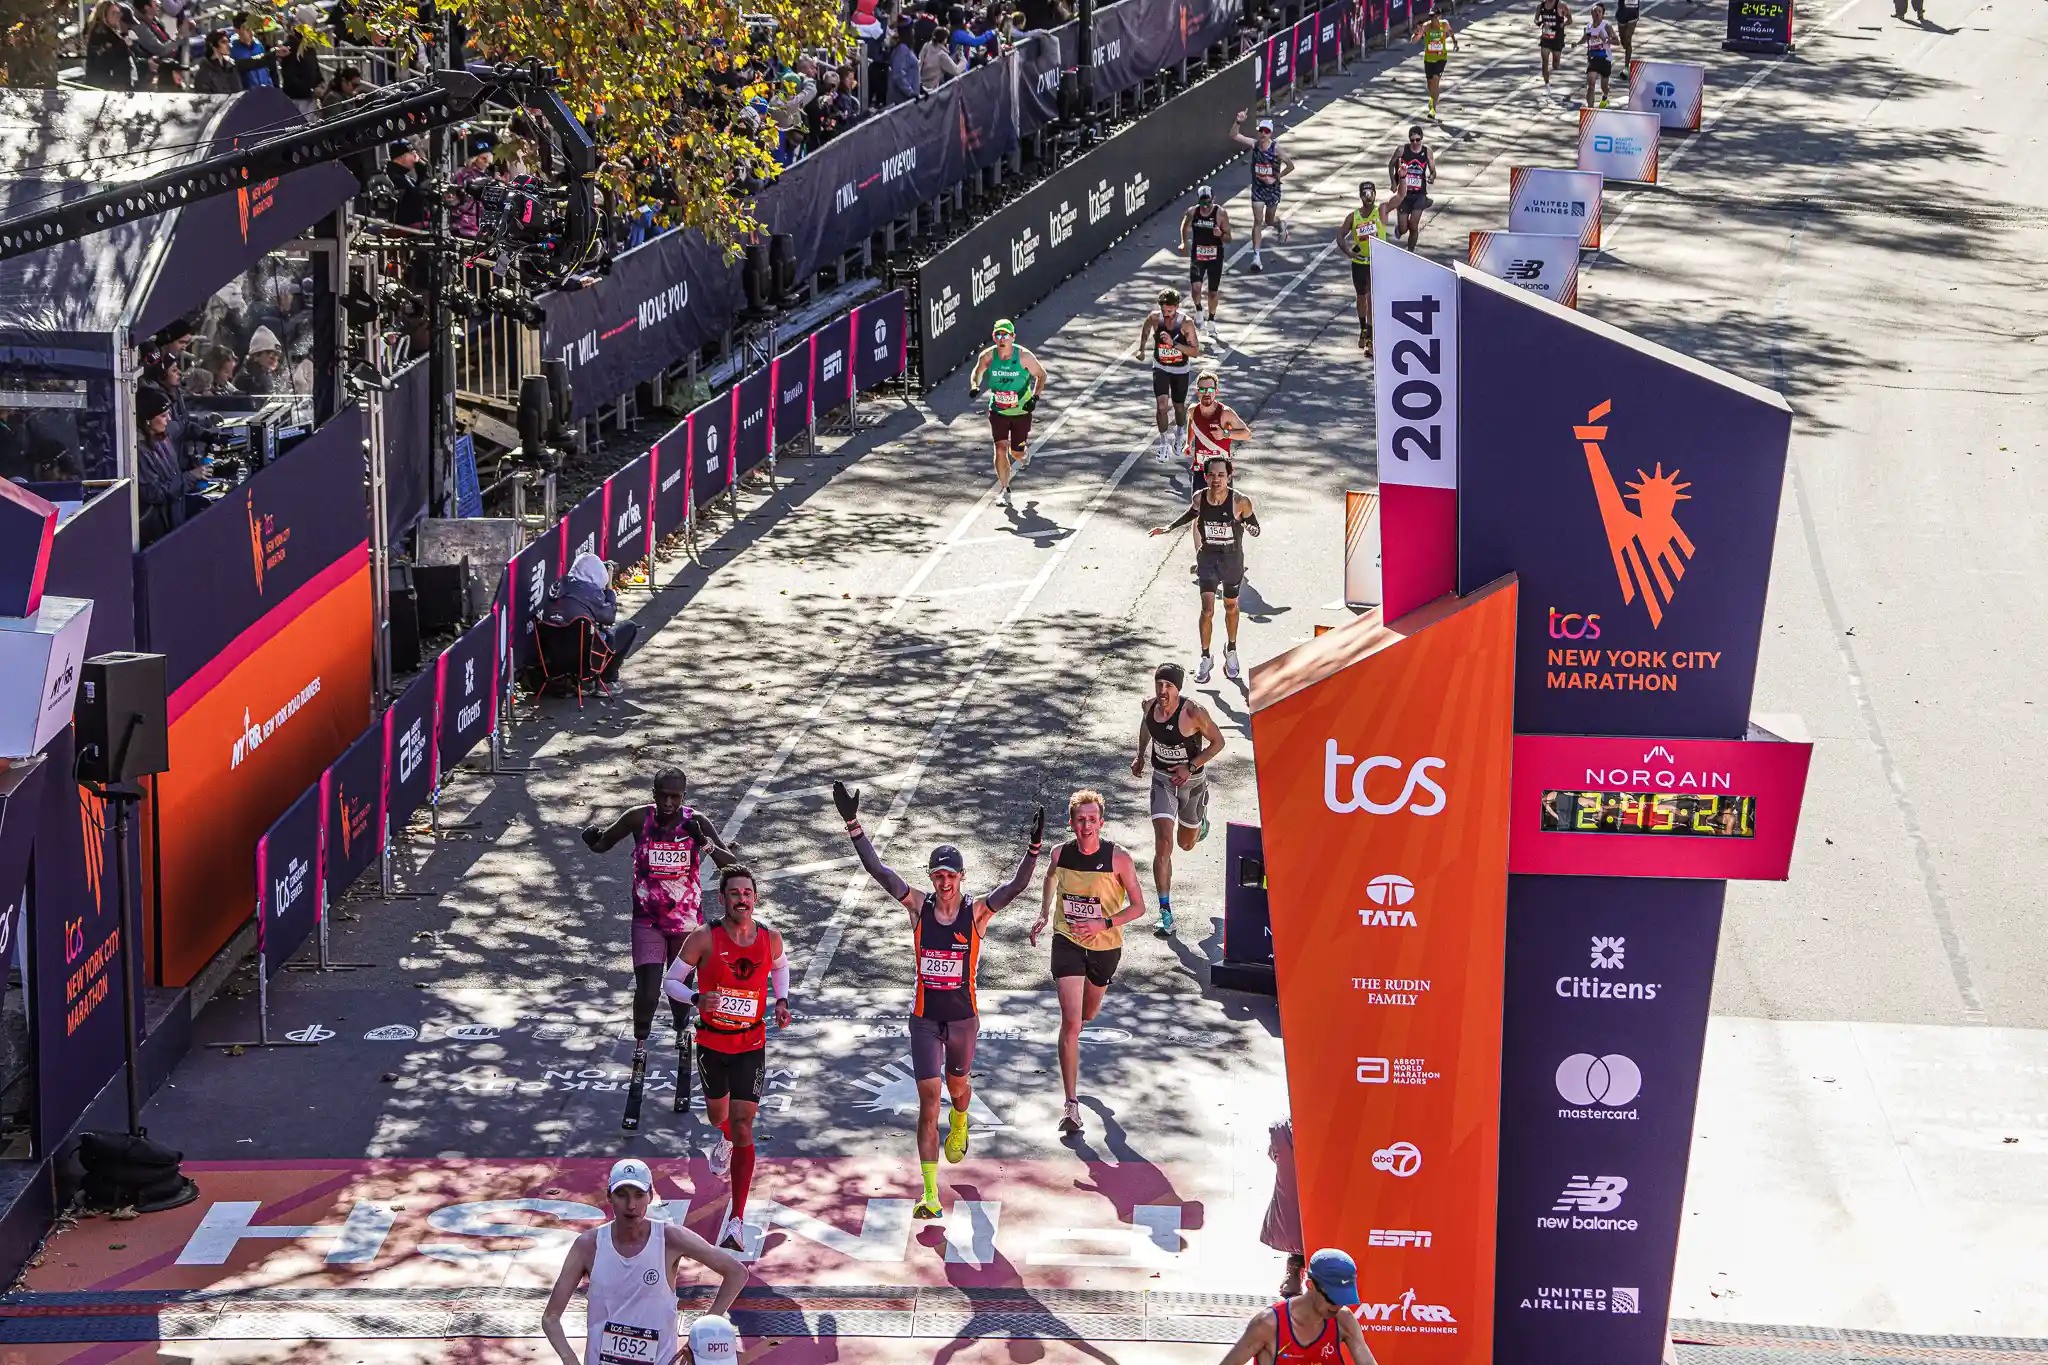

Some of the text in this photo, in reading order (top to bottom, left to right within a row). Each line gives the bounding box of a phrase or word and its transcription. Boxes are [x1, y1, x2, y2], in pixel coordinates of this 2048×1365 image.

[1092, 47, 1106, 68] OVE
[1106, 39, 1120, 62] YOU
[1652, 99, 1677, 108] TATA
[902, 146, 917, 173] YOU
[1088, 189, 1100, 225] tcs
[1125, 182, 1136, 217] tcs
[1533, 200, 1568, 208] UNITED
[1524, 206, 1569, 215] AIRLINES
[1050, 211, 1062, 248] tcs
[1011, 238, 1024, 276] tcs
[972, 267, 984, 307] tcs
[562, 280, 688, 371] IT WILL MOVE YOU
[931, 298, 944, 339] tcs
[874, 344, 888, 362] TATA
[1391, 294, 1442, 462] 2024
[706, 455, 719, 474] TATA
[1209, 526, 1227, 535] 1547
[1549, 606, 1601, 640] tcs
[1548, 649, 1722, 669] NEW YORK CITY
[1547, 671, 1677, 691] MARATHON
[263, 716, 275, 740] NEW
[274, 704, 288, 728] YORK
[287, 694, 301, 718] ROAD
[300, 676, 321, 707] RUNNERS
[457, 699, 481, 733] Citizens
[1324, 738, 1447, 816] tcs
[1585, 768, 1731, 789] NORQAIN
[652, 851, 688, 863] 14328
[276, 875, 290, 917] tcs
[290, 881, 304, 903] SERVICES
[1069, 902, 1095, 915] 1520
[1358, 910, 1418, 927] TATA
[66, 916, 83, 965] tcs
[66, 926, 120, 1004] NEW YORK CITY
[926, 959, 956, 973] 2857
[1351, 977, 1431, 991] THE RUDIN
[1555, 976, 1658, 1000] Citizens
[67, 973, 108, 1037] MARATHON
[721, 997, 752, 1013] 2375
[1367, 992, 1418, 1006] FAMILY
[456, 1026, 501, 1038] MTA
[1373, 1155, 1393, 1163] abc
[1537, 1215, 1639, 1231] new balance
[1368, 1229, 1433, 1248] ESPN
[1537, 1287, 1607, 1299] UNITED
[1520, 1298, 1607, 1311] AIRLINES
[610, 1324, 623, 1333] tcs
[1394, 1325, 1418, 1333] ROAD
[1419, 1326, 1458, 1334] RUNNERS
[611, 1335, 648, 1356] 1652
[707, 1342, 729, 1353] PPTC
